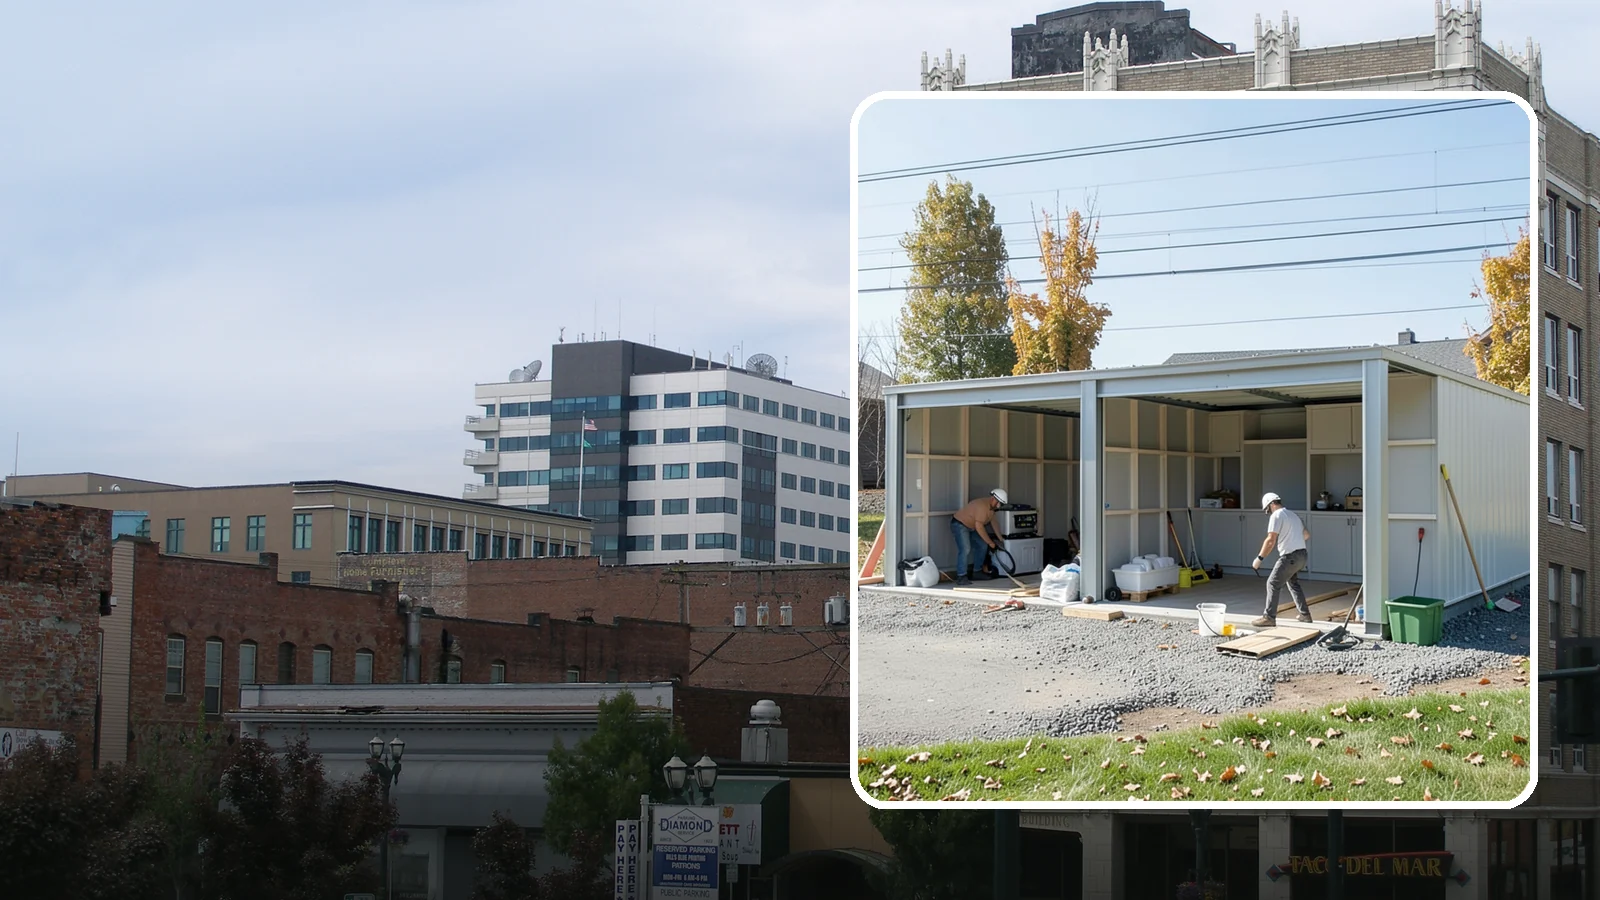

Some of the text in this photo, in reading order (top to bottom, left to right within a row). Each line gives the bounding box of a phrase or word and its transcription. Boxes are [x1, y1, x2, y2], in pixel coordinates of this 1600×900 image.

[343, 565, 427, 577] Home Furnishers
[660, 818, 713, 833] DIAMOND
[1022, 815, 1070, 828] BUILDING
[656, 845, 716, 854] RESERVED PARKING
[616, 824, 625, 894] PAY HERE
[627, 824, 637, 893] PAY HERE
[721, 851, 739, 862] Soup
[671, 862, 701, 870] PATRONS
[1289, 855, 1442, 877] TAC DEL MAR
[660, 888, 710, 898] PUBLIC PARKING
